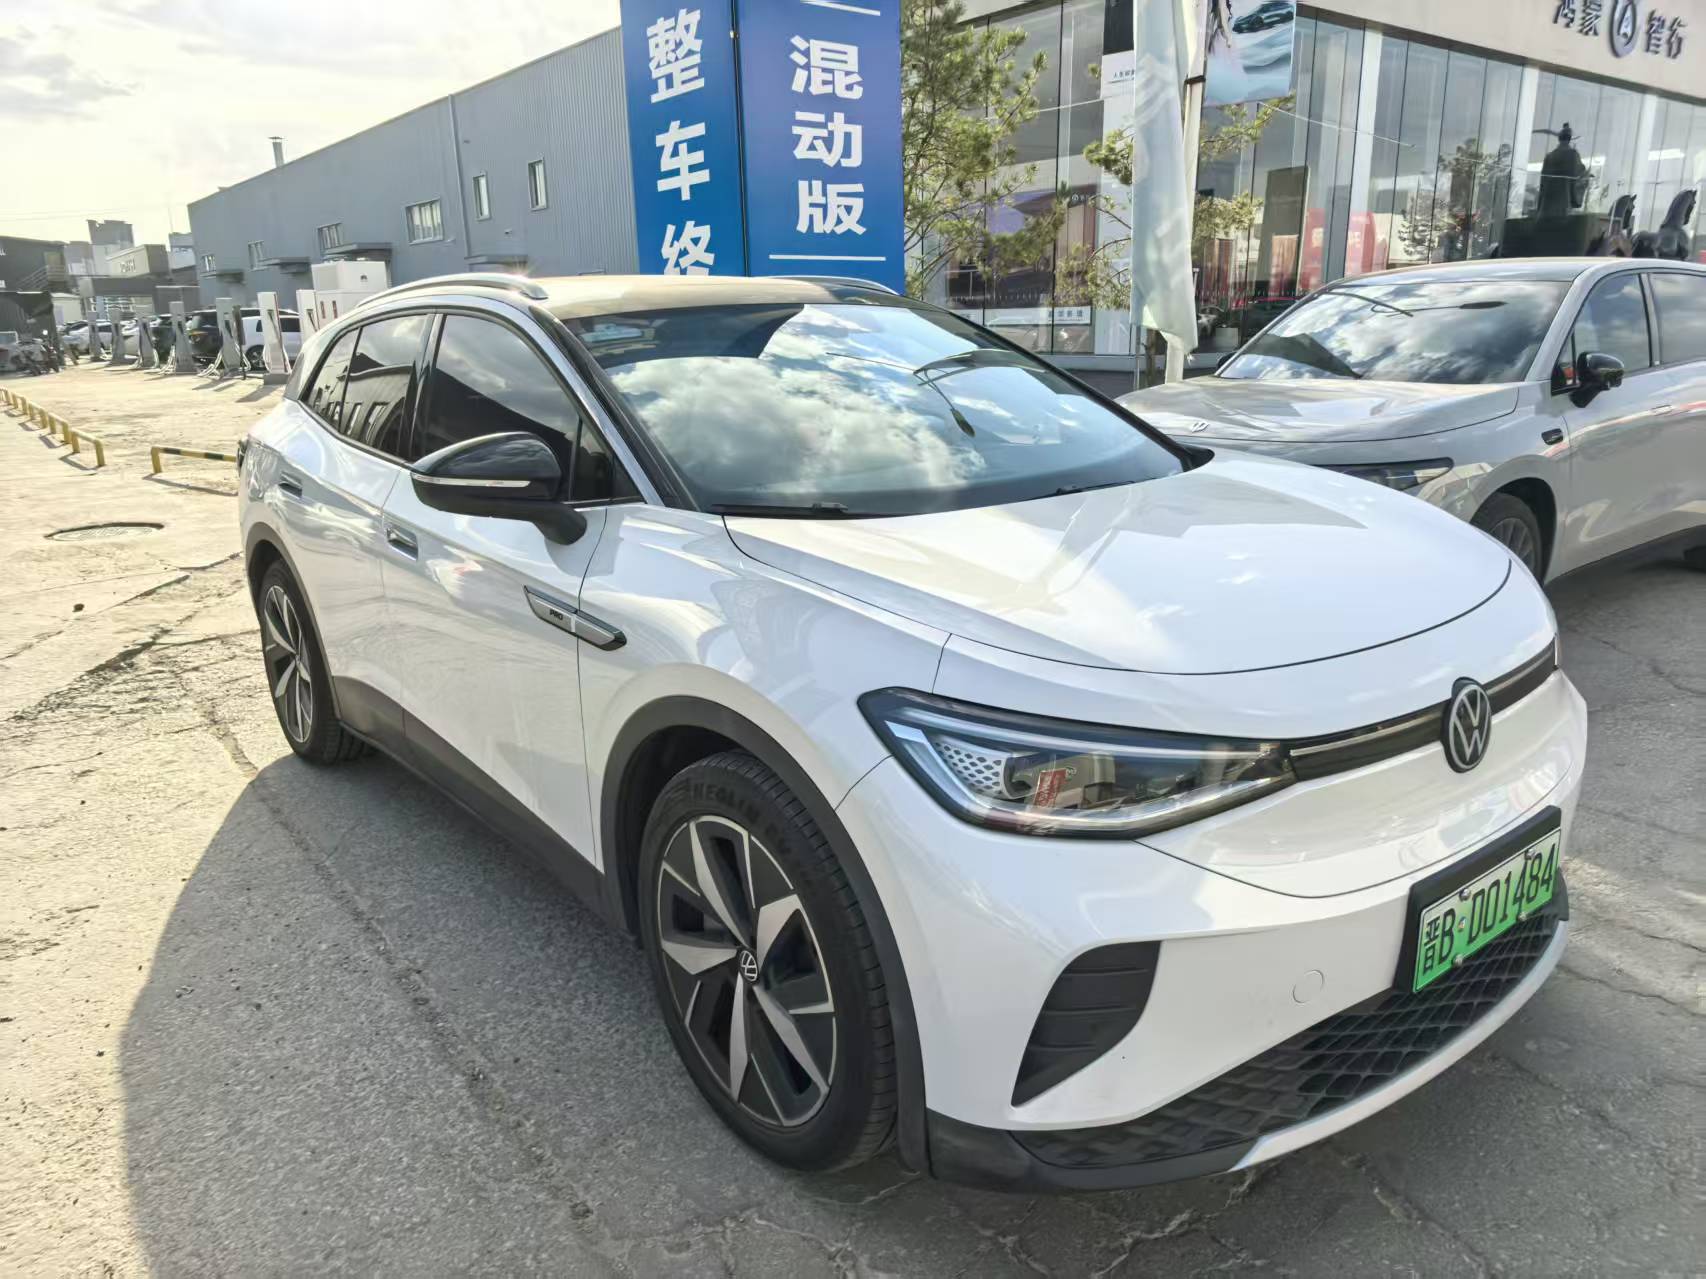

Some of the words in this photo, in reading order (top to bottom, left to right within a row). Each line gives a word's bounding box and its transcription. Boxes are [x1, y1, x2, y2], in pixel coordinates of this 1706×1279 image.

[646, 8, 715, 276] 整车终
[789, 34, 867, 236] 混动版
